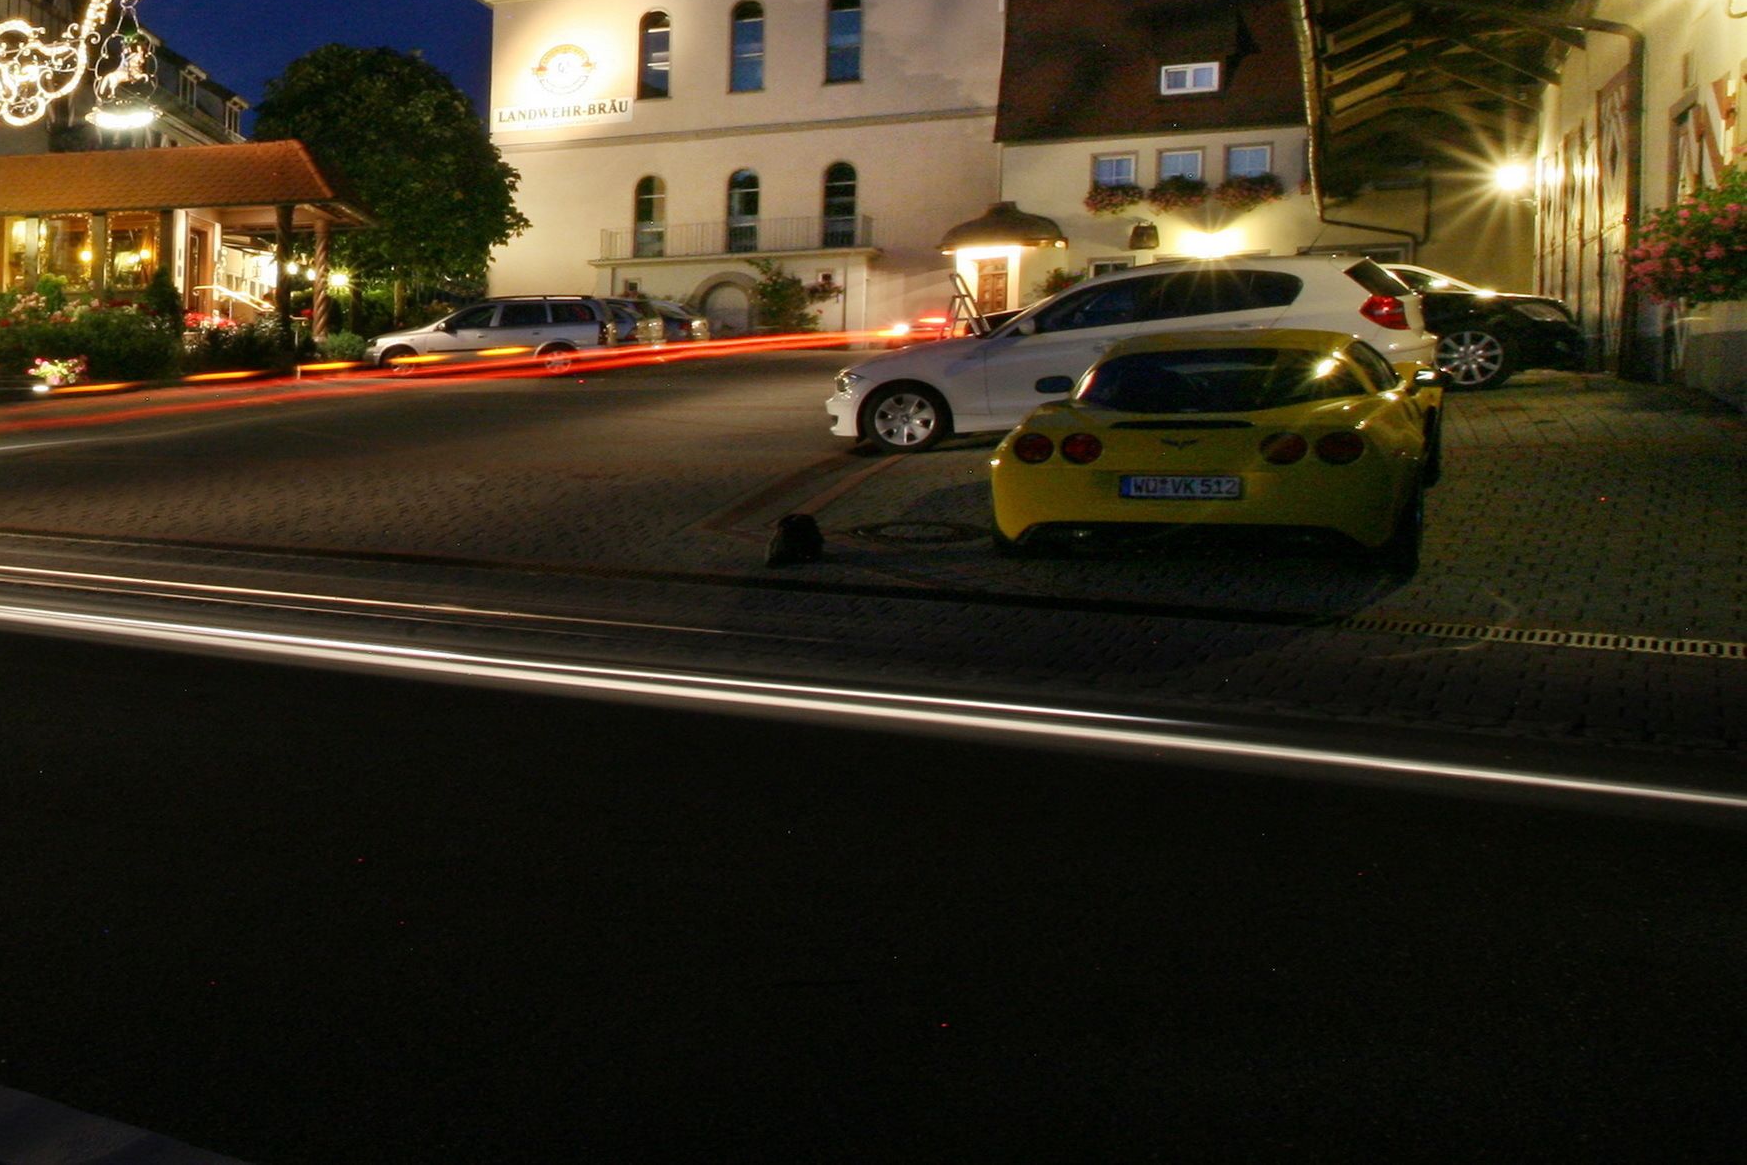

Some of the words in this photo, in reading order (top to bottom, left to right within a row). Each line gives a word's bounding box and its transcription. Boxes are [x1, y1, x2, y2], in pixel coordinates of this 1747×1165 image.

[498, 99, 629, 123] LANDWEHR-BRÄU
[1170, 478, 1196, 494] VK
[1200, 478, 1238, 495] 512
